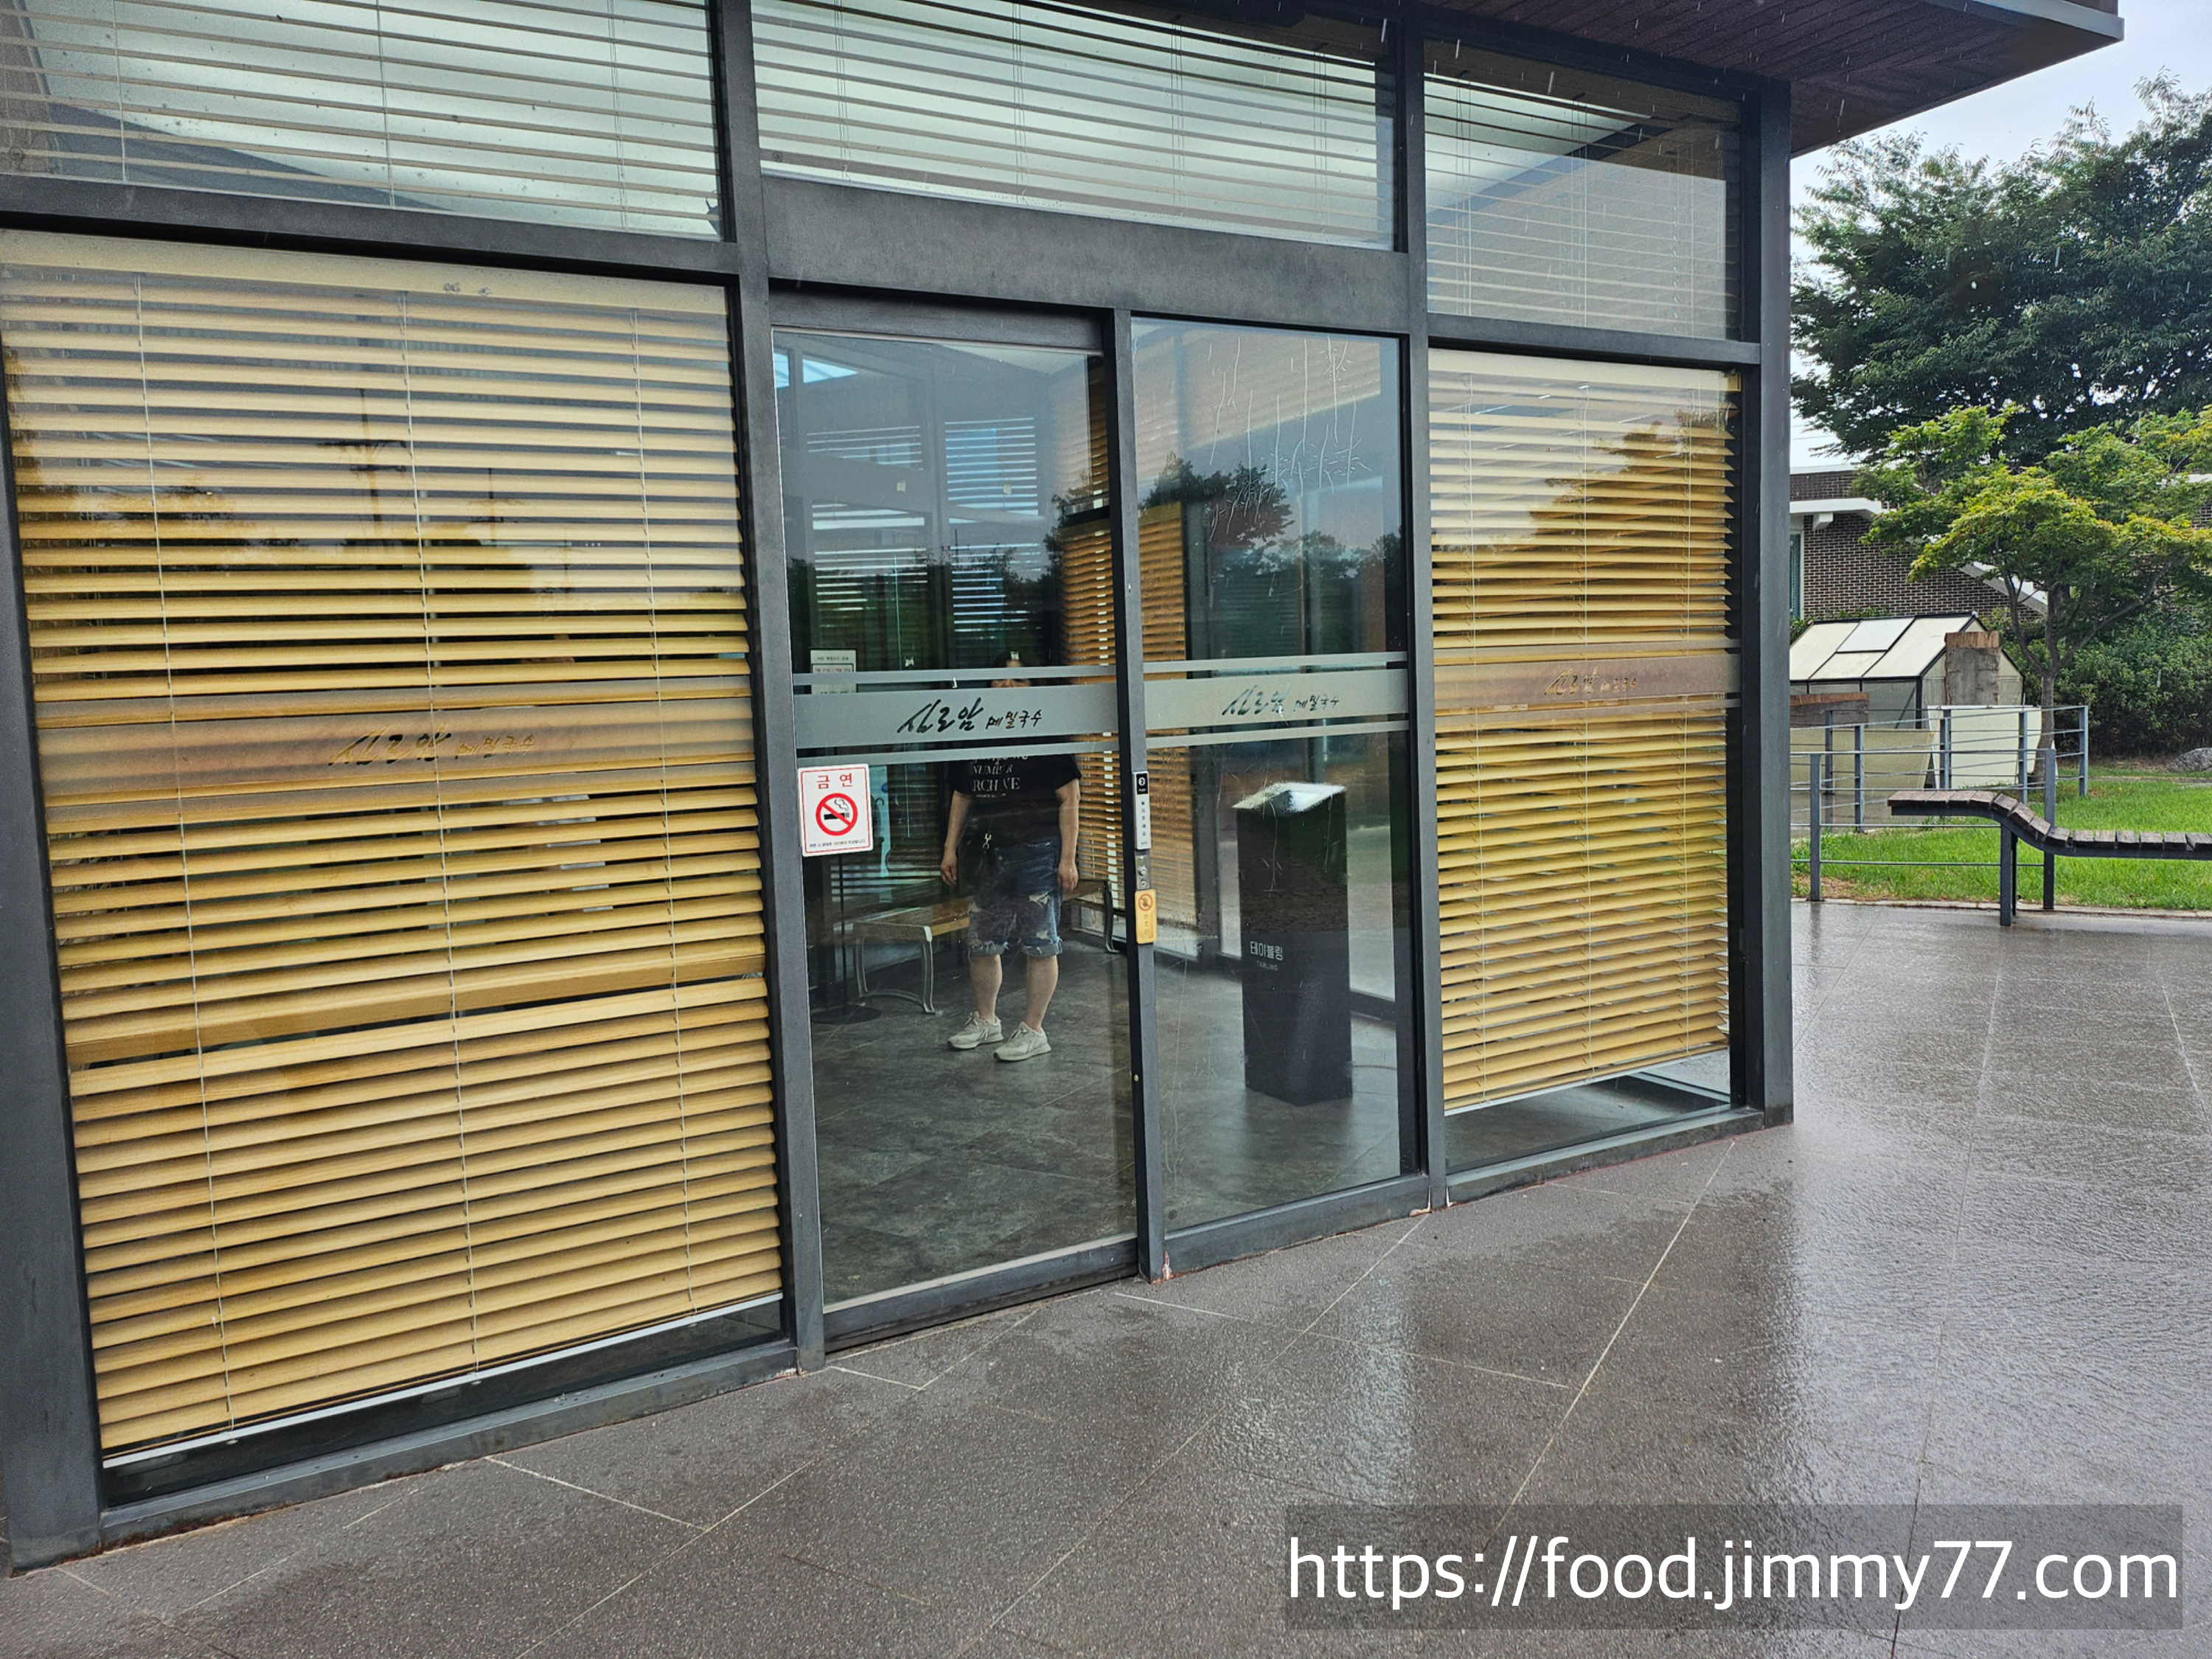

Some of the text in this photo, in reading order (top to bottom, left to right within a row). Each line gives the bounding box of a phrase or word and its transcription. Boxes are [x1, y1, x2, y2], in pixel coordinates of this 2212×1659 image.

[1293, 694, 1340, 712] 메밀국수
[985, 709, 1042, 729] 메밀국수
[454, 734, 535, 759] 메밀국수
[973, 777, 1020, 791] RCHVE
[1250, 941, 1283, 961] 테이블링
